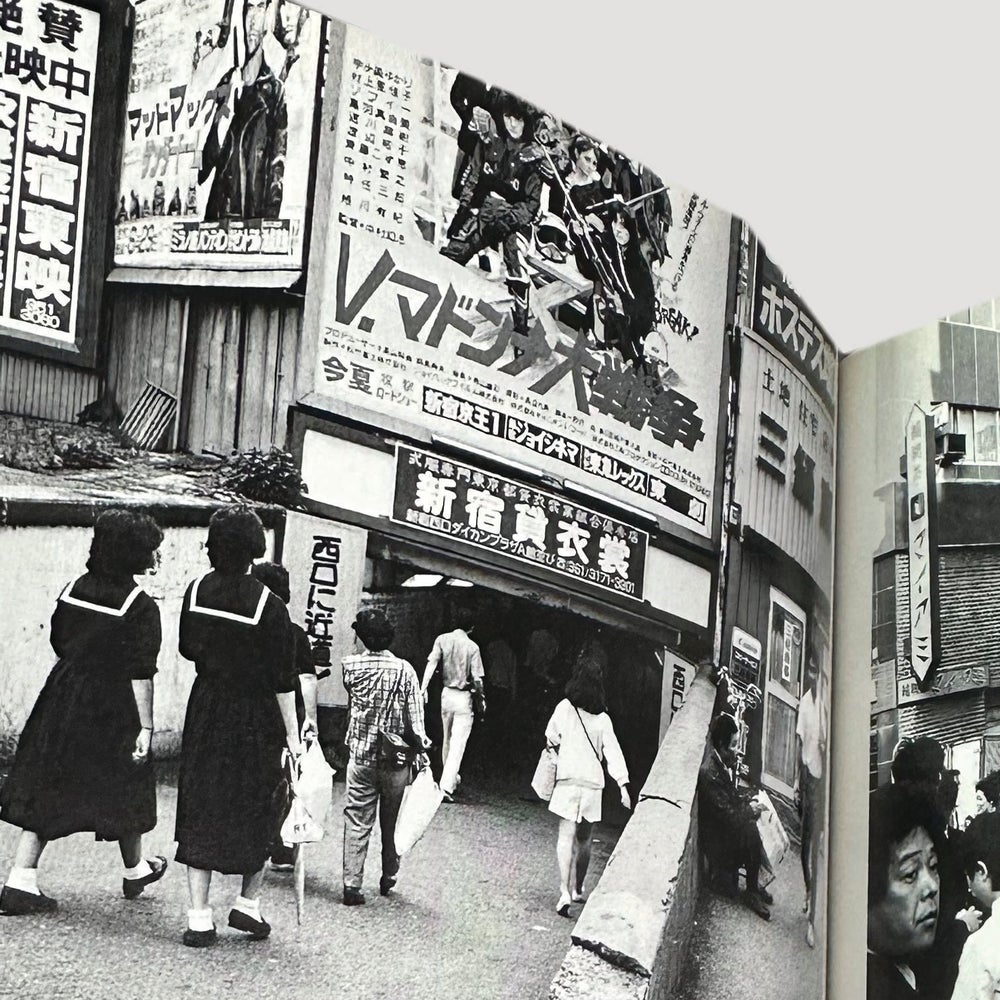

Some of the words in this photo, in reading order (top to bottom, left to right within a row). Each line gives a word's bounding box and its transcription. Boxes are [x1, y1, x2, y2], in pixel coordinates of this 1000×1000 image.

[0, 46, 91, 99] 映中
[16, 101, 84, 307] 新宿東映
[322, 355, 374, 396] 今夏
[414, 471, 633, 579] 新宿貸衣裳
